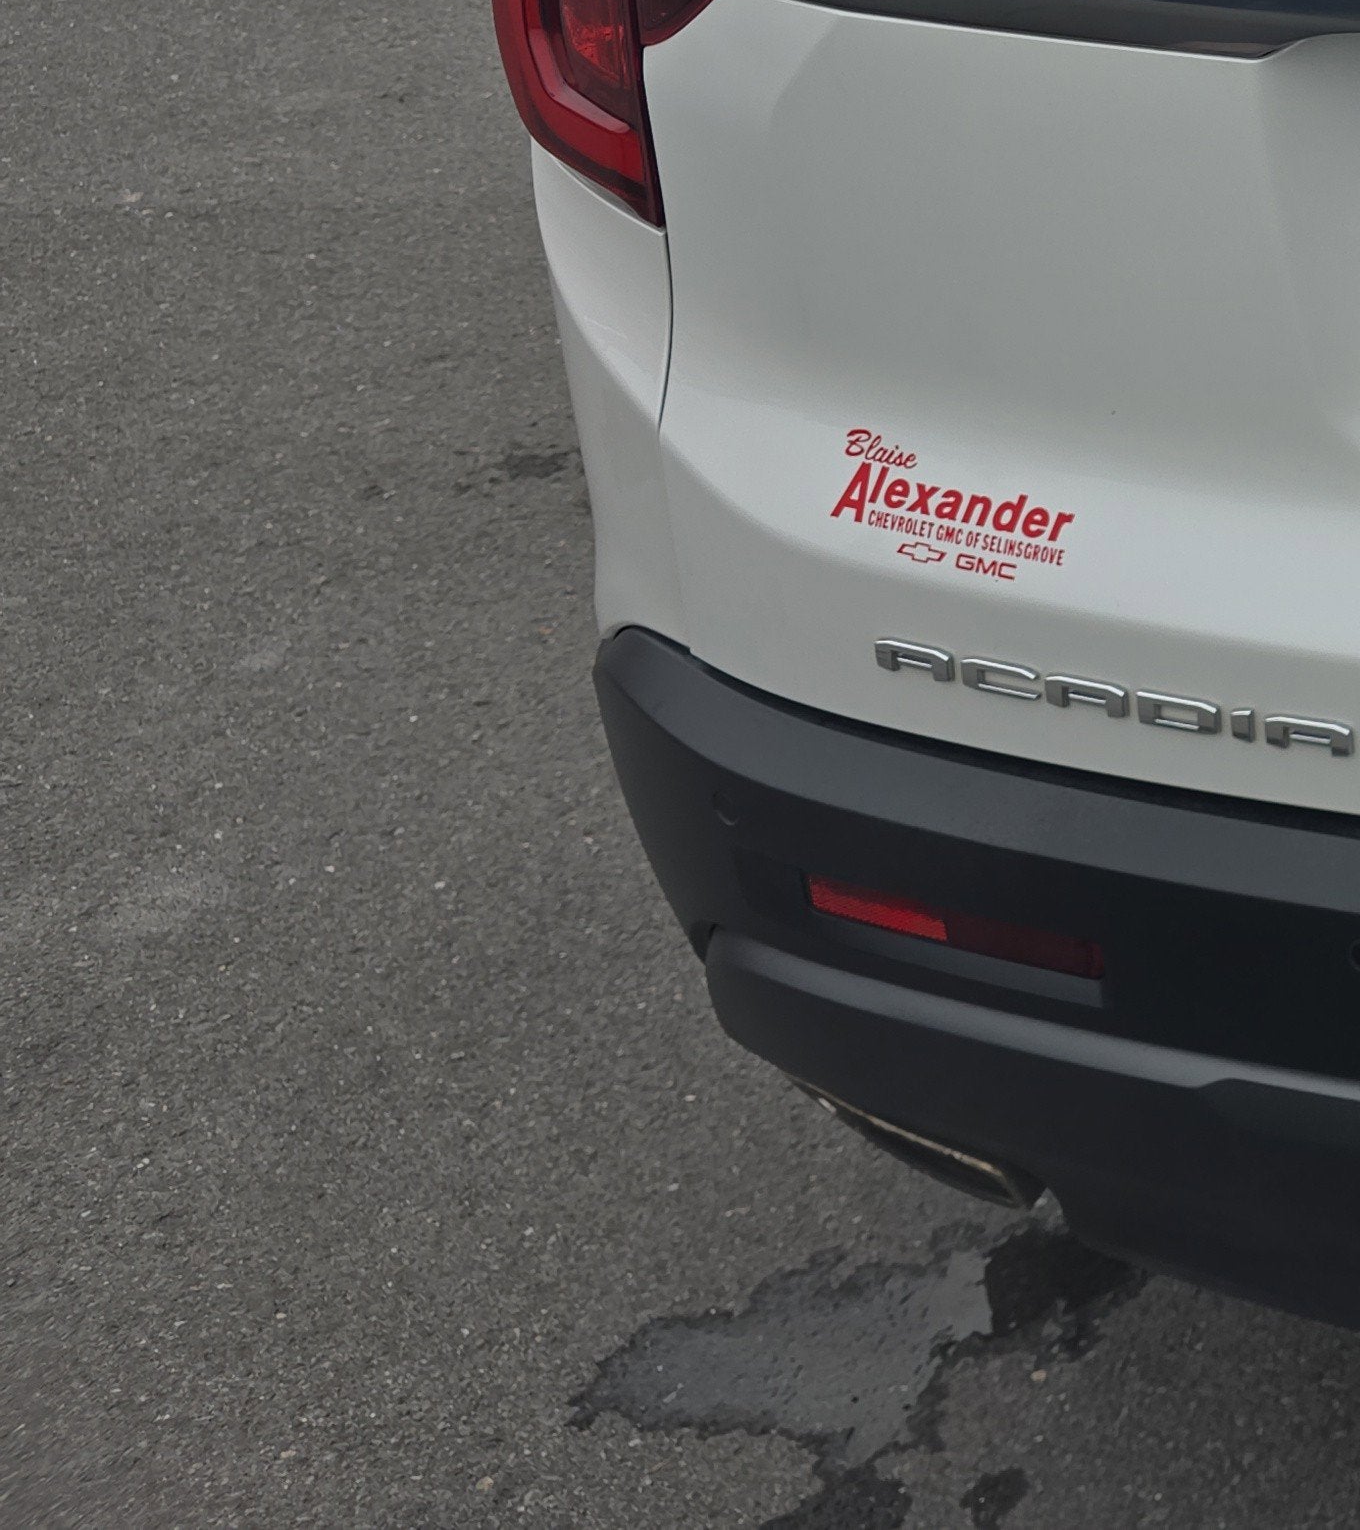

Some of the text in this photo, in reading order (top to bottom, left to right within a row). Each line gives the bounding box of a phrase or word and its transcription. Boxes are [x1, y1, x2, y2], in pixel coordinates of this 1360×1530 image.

[845, 429, 917, 469] Blaise
[830, 461, 1075, 542] Alexander
[868, 510, 1065, 566] CHEVROLET GMC OF SELINSGROVE
[955, 553, 1018, 581] GMC
[874, 637, 1355, 758] ACADIA
